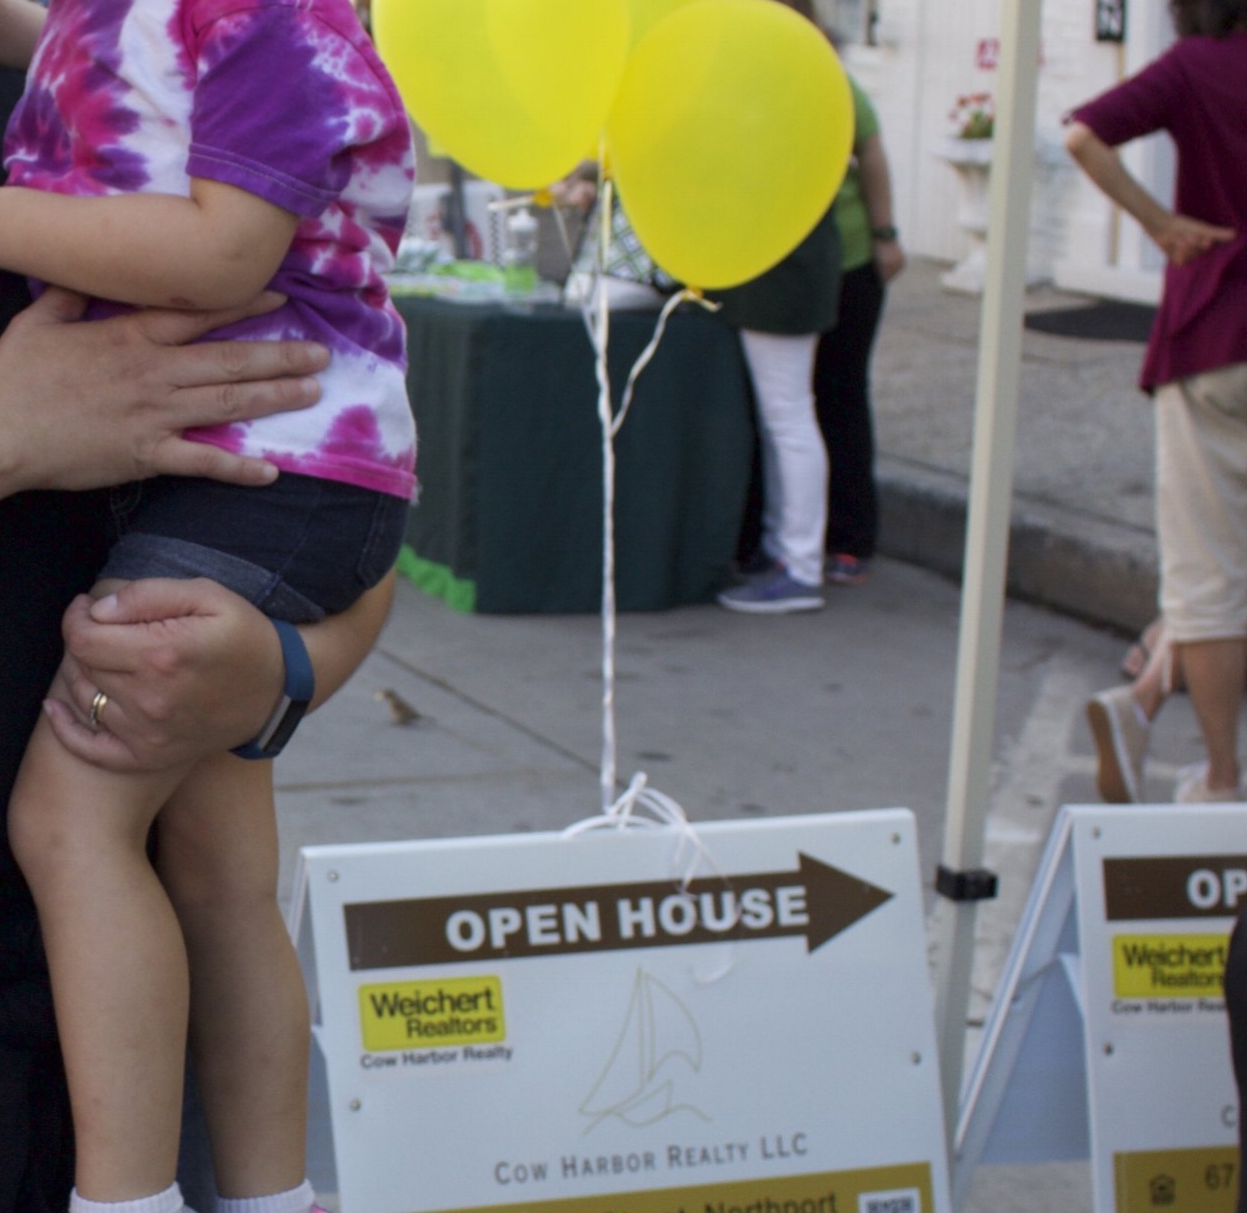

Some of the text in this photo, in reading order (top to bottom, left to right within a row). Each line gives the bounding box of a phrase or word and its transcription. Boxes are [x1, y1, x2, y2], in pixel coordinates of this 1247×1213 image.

[445, 885, 810, 952] OPEN HOUSE
[1122, 942, 1226, 968] Weichert
[1152, 967, 1224, 988] Realtor
[370, 985, 496, 1019] Weichert
[406, 1016, 498, 1038] Realtors
[360, 1045, 513, 1069] Cow Harbor Realty
[760, 1131, 808, 1160] LLC
